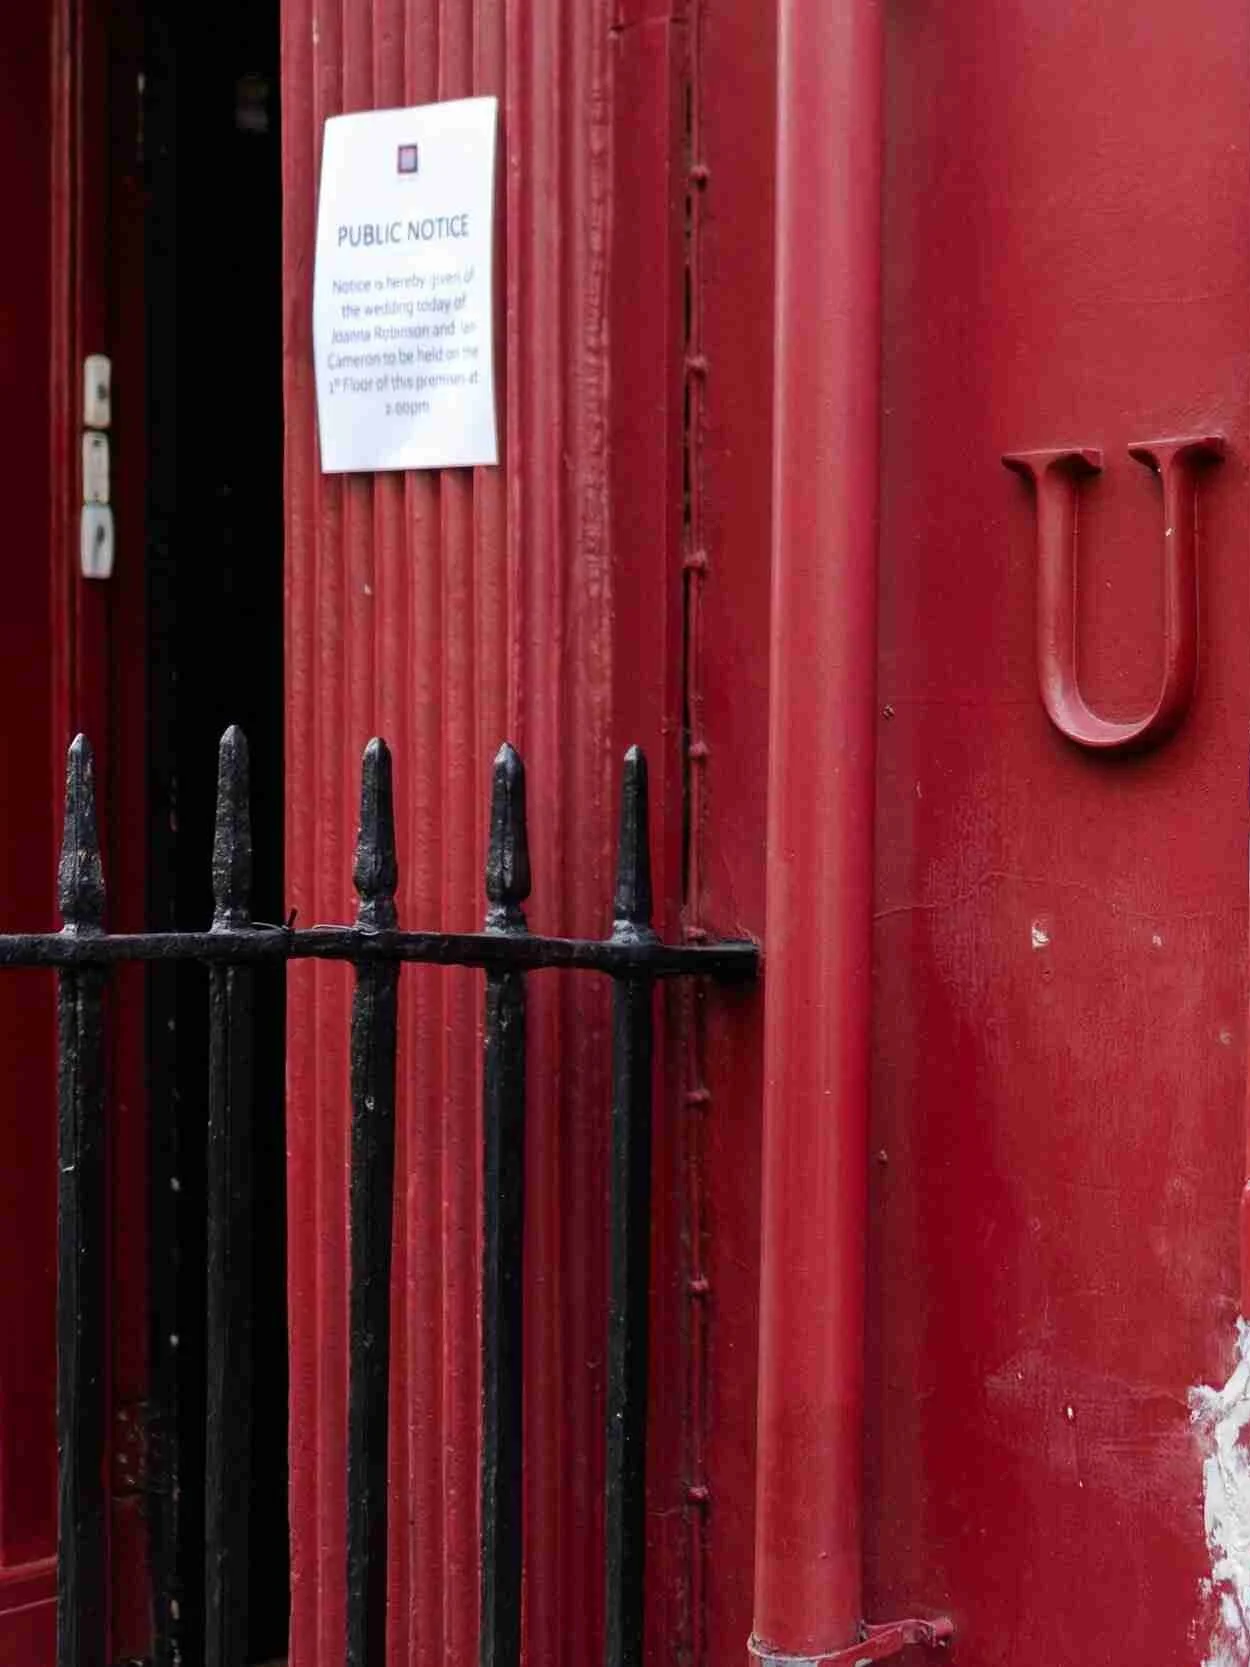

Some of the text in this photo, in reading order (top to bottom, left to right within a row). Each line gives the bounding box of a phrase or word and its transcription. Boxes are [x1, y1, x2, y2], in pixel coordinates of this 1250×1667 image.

[338, 214, 470, 247] PUBLIC NOTICE
[333, 279, 371, 295] Notice
[386, 274, 424, 289] hereby
[463, 265, 475, 283] of
[341, 291, 467, 319] the wedding today of
[432, 321, 455, 336] and
[327, 352, 381, 370] Cameron
[383, 352, 396, 365] to
[398, 348, 413, 363] be
[417, 345, 442, 362] held
[462, 346, 478, 358] the
[343, 377, 372, 392] Floor
[376, 374, 388, 391] of
[391, 373, 413, 391] this
[1002, 436, 1225, 747] U
